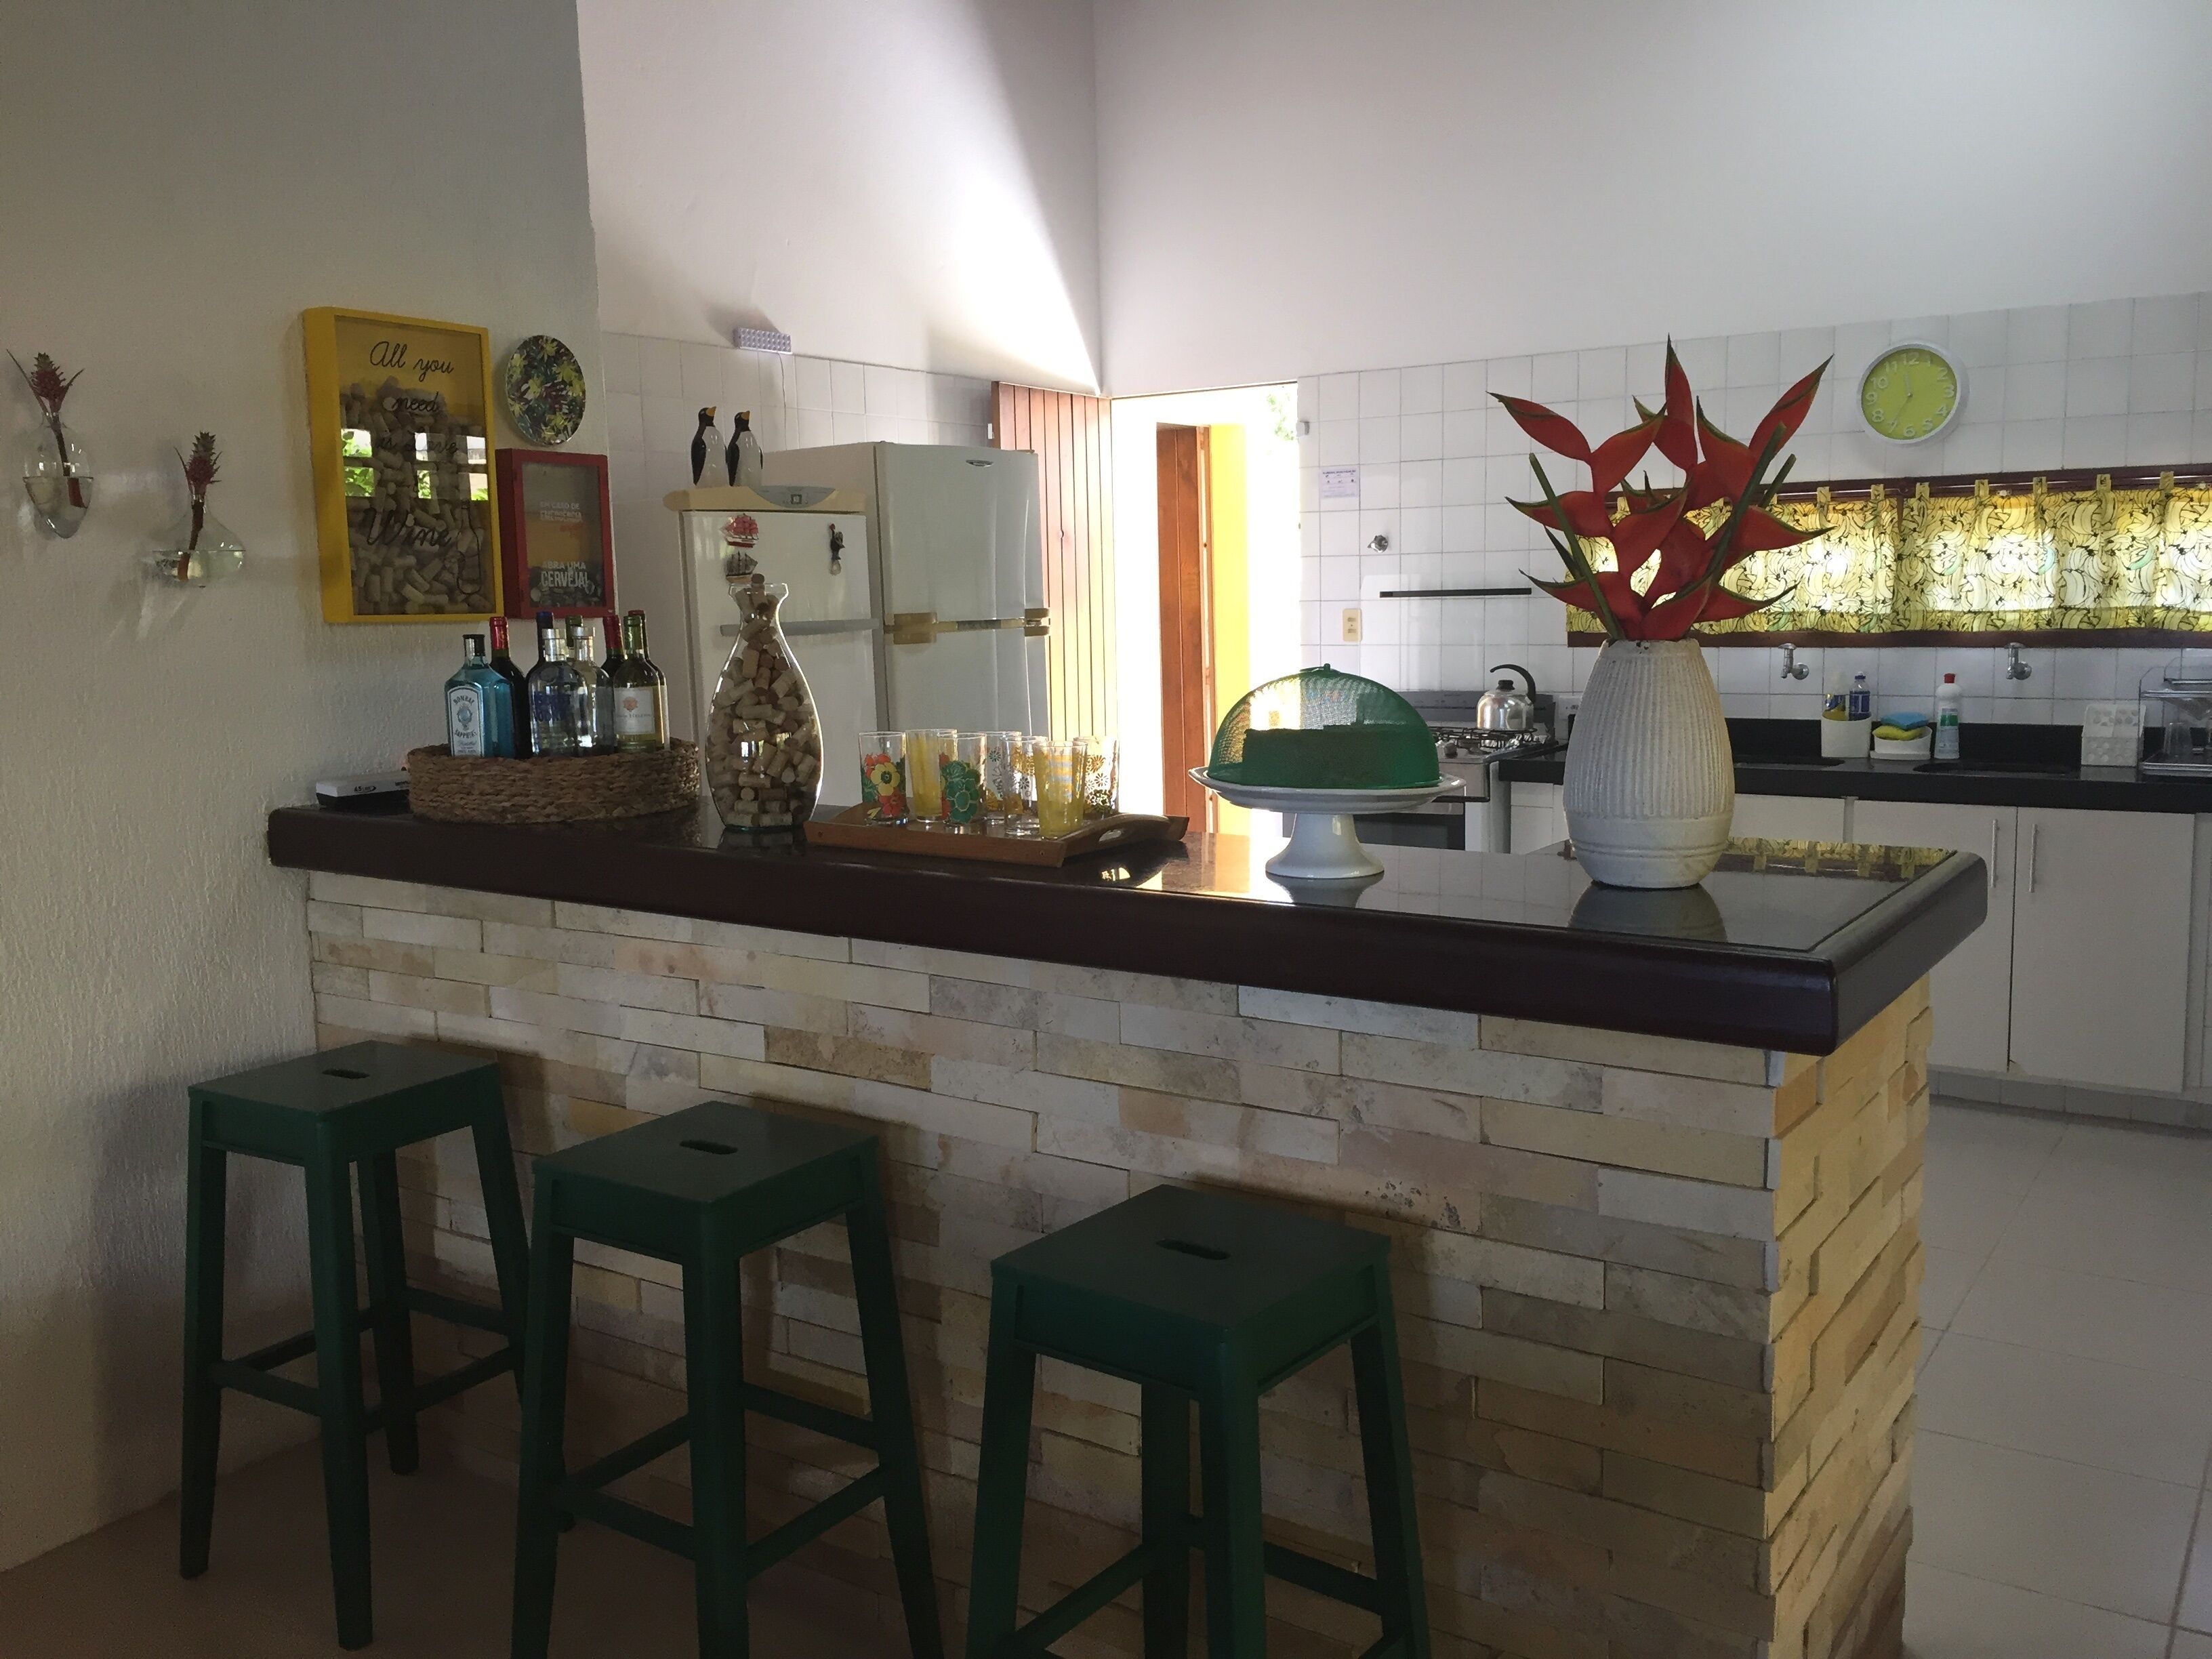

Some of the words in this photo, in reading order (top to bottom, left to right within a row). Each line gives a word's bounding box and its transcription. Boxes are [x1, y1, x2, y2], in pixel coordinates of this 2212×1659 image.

[370, 341, 408, 368] All
[413, 358, 454, 382] you
[1900, 352, 1919, 366] 12
[1884, 361, 1898, 373] 11
[1937, 367, 1948, 381] 2
[1870, 375, 1888, 390] 10
[1944, 384, 1954, 398] 3
[391, 391, 441, 412] need
[1866, 392, 1877, 405] 9
[1871, 409, 1884, 422] 8
[1936, 403, 1948, 417] 4
[1904, 425, 1916, 437] 6
[567, 561, 586, 570] UMA
[453, 695, 475, 705] BOMBAY
